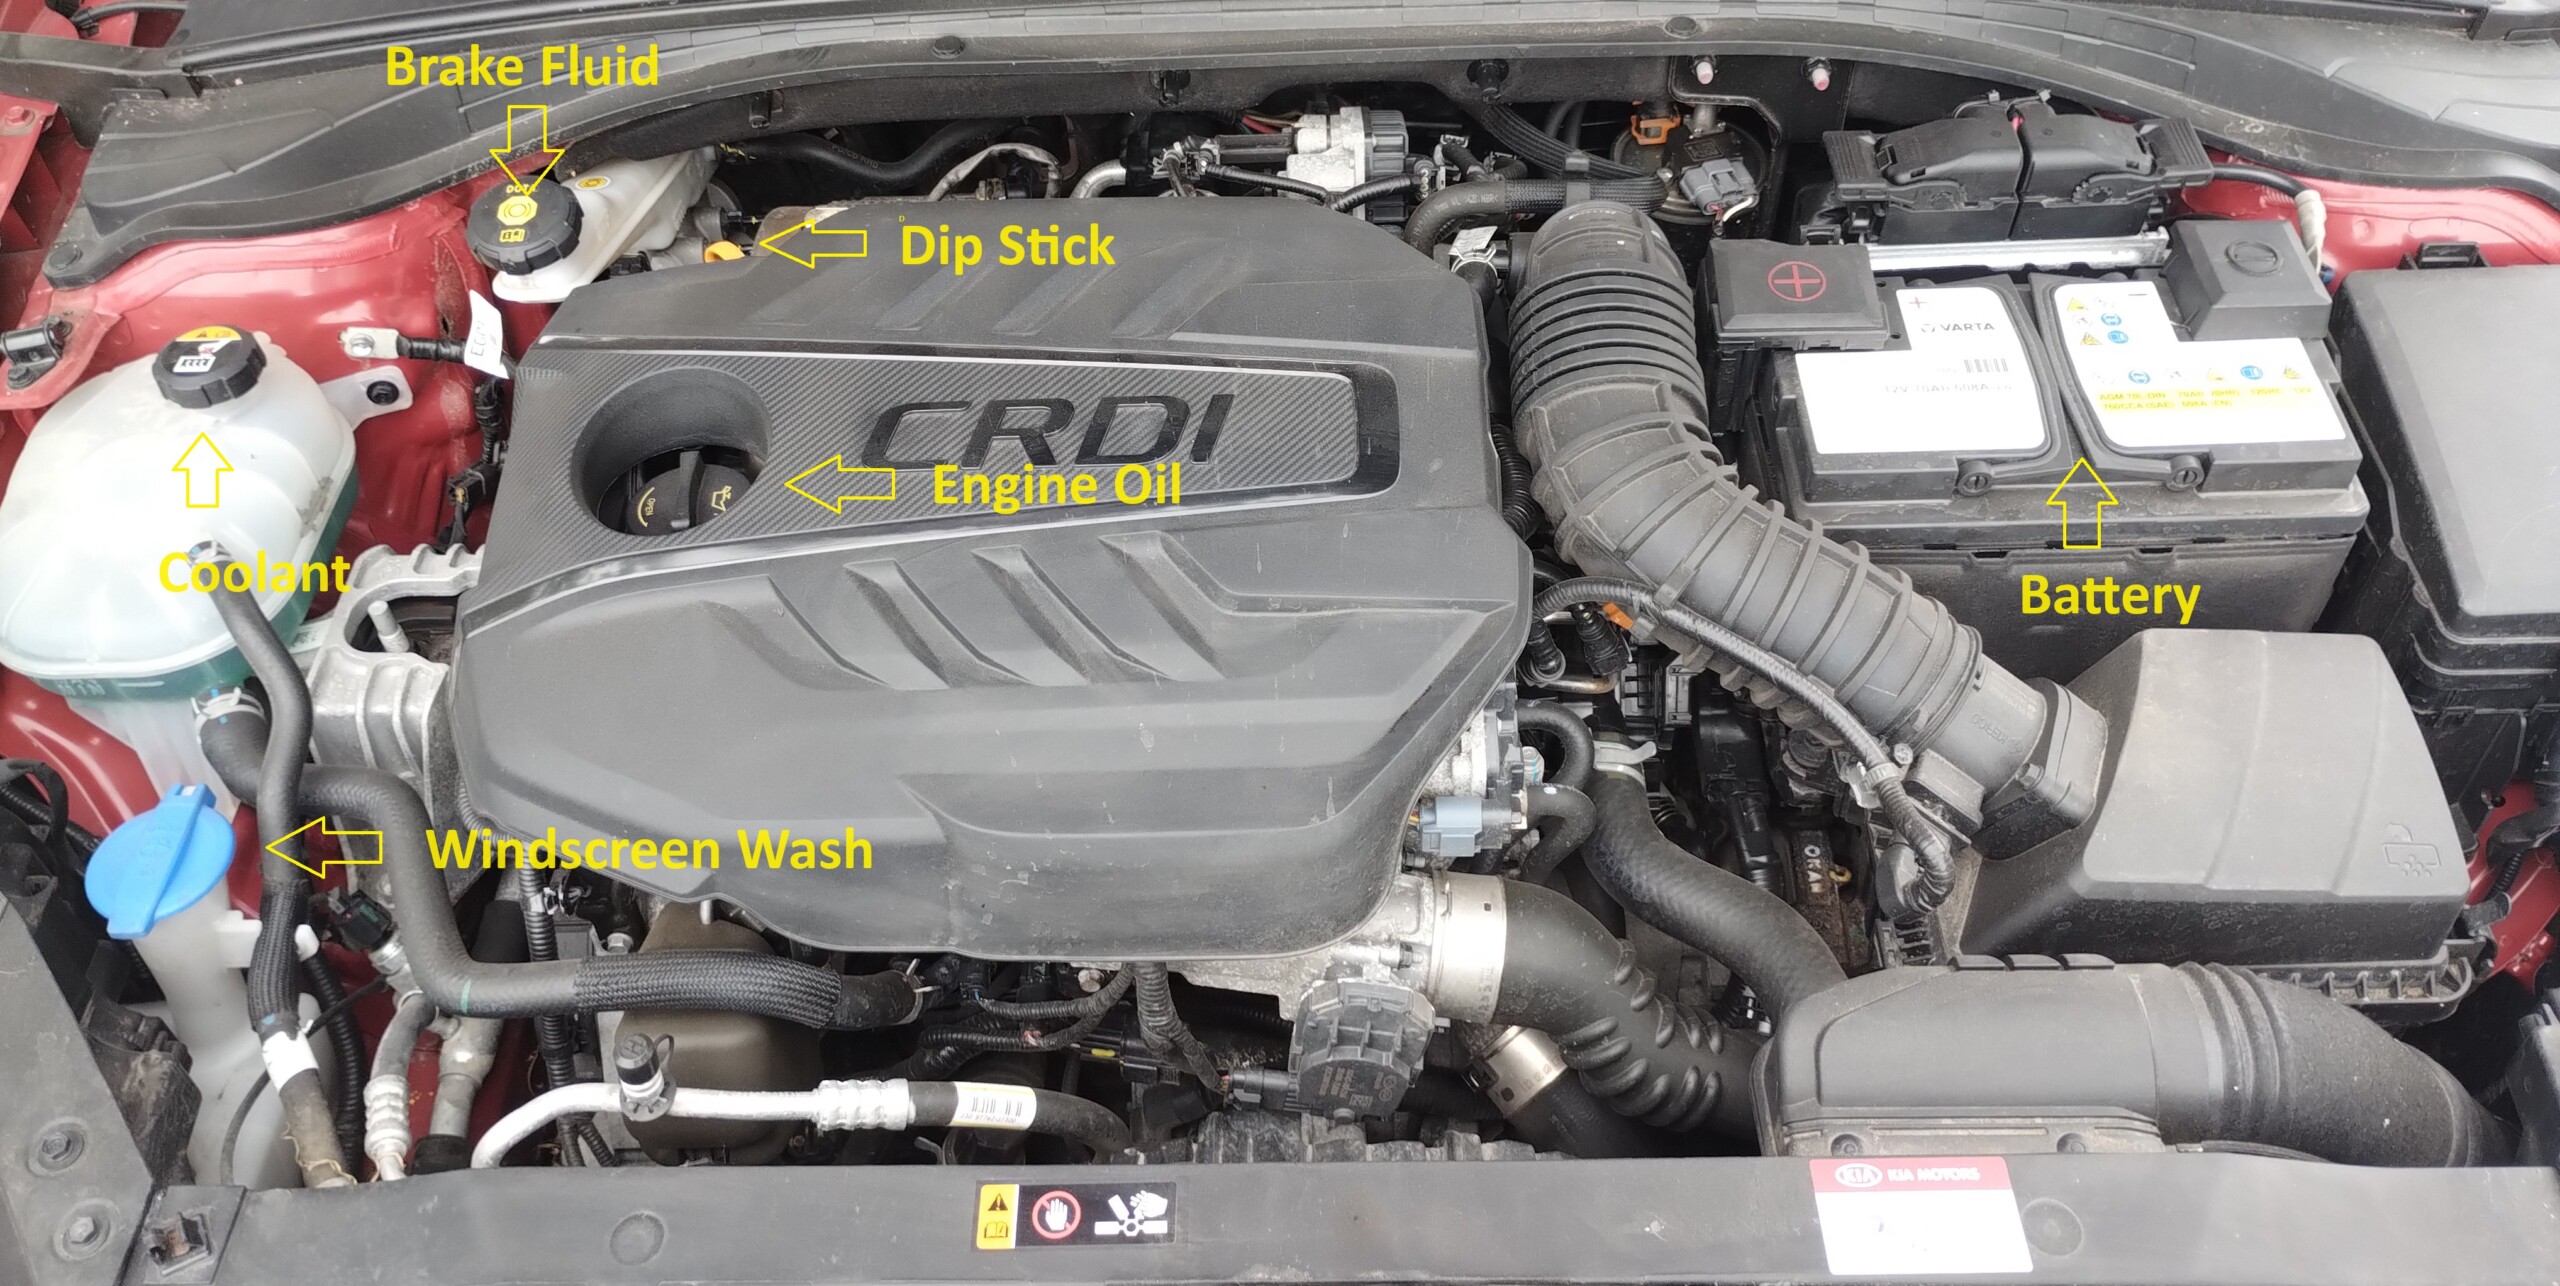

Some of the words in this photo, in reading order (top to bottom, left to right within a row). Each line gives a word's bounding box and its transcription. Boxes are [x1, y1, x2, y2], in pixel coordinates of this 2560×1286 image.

[1939, 322, 1995, 332] VARTA
[861, 394, 1235, 470] CRDI
[1844, 1166, 1875, 1184] KIA
[1887, 1168, 1915, 1182] KIA
[1917, 1167, 1981, 1182] MOTORS
